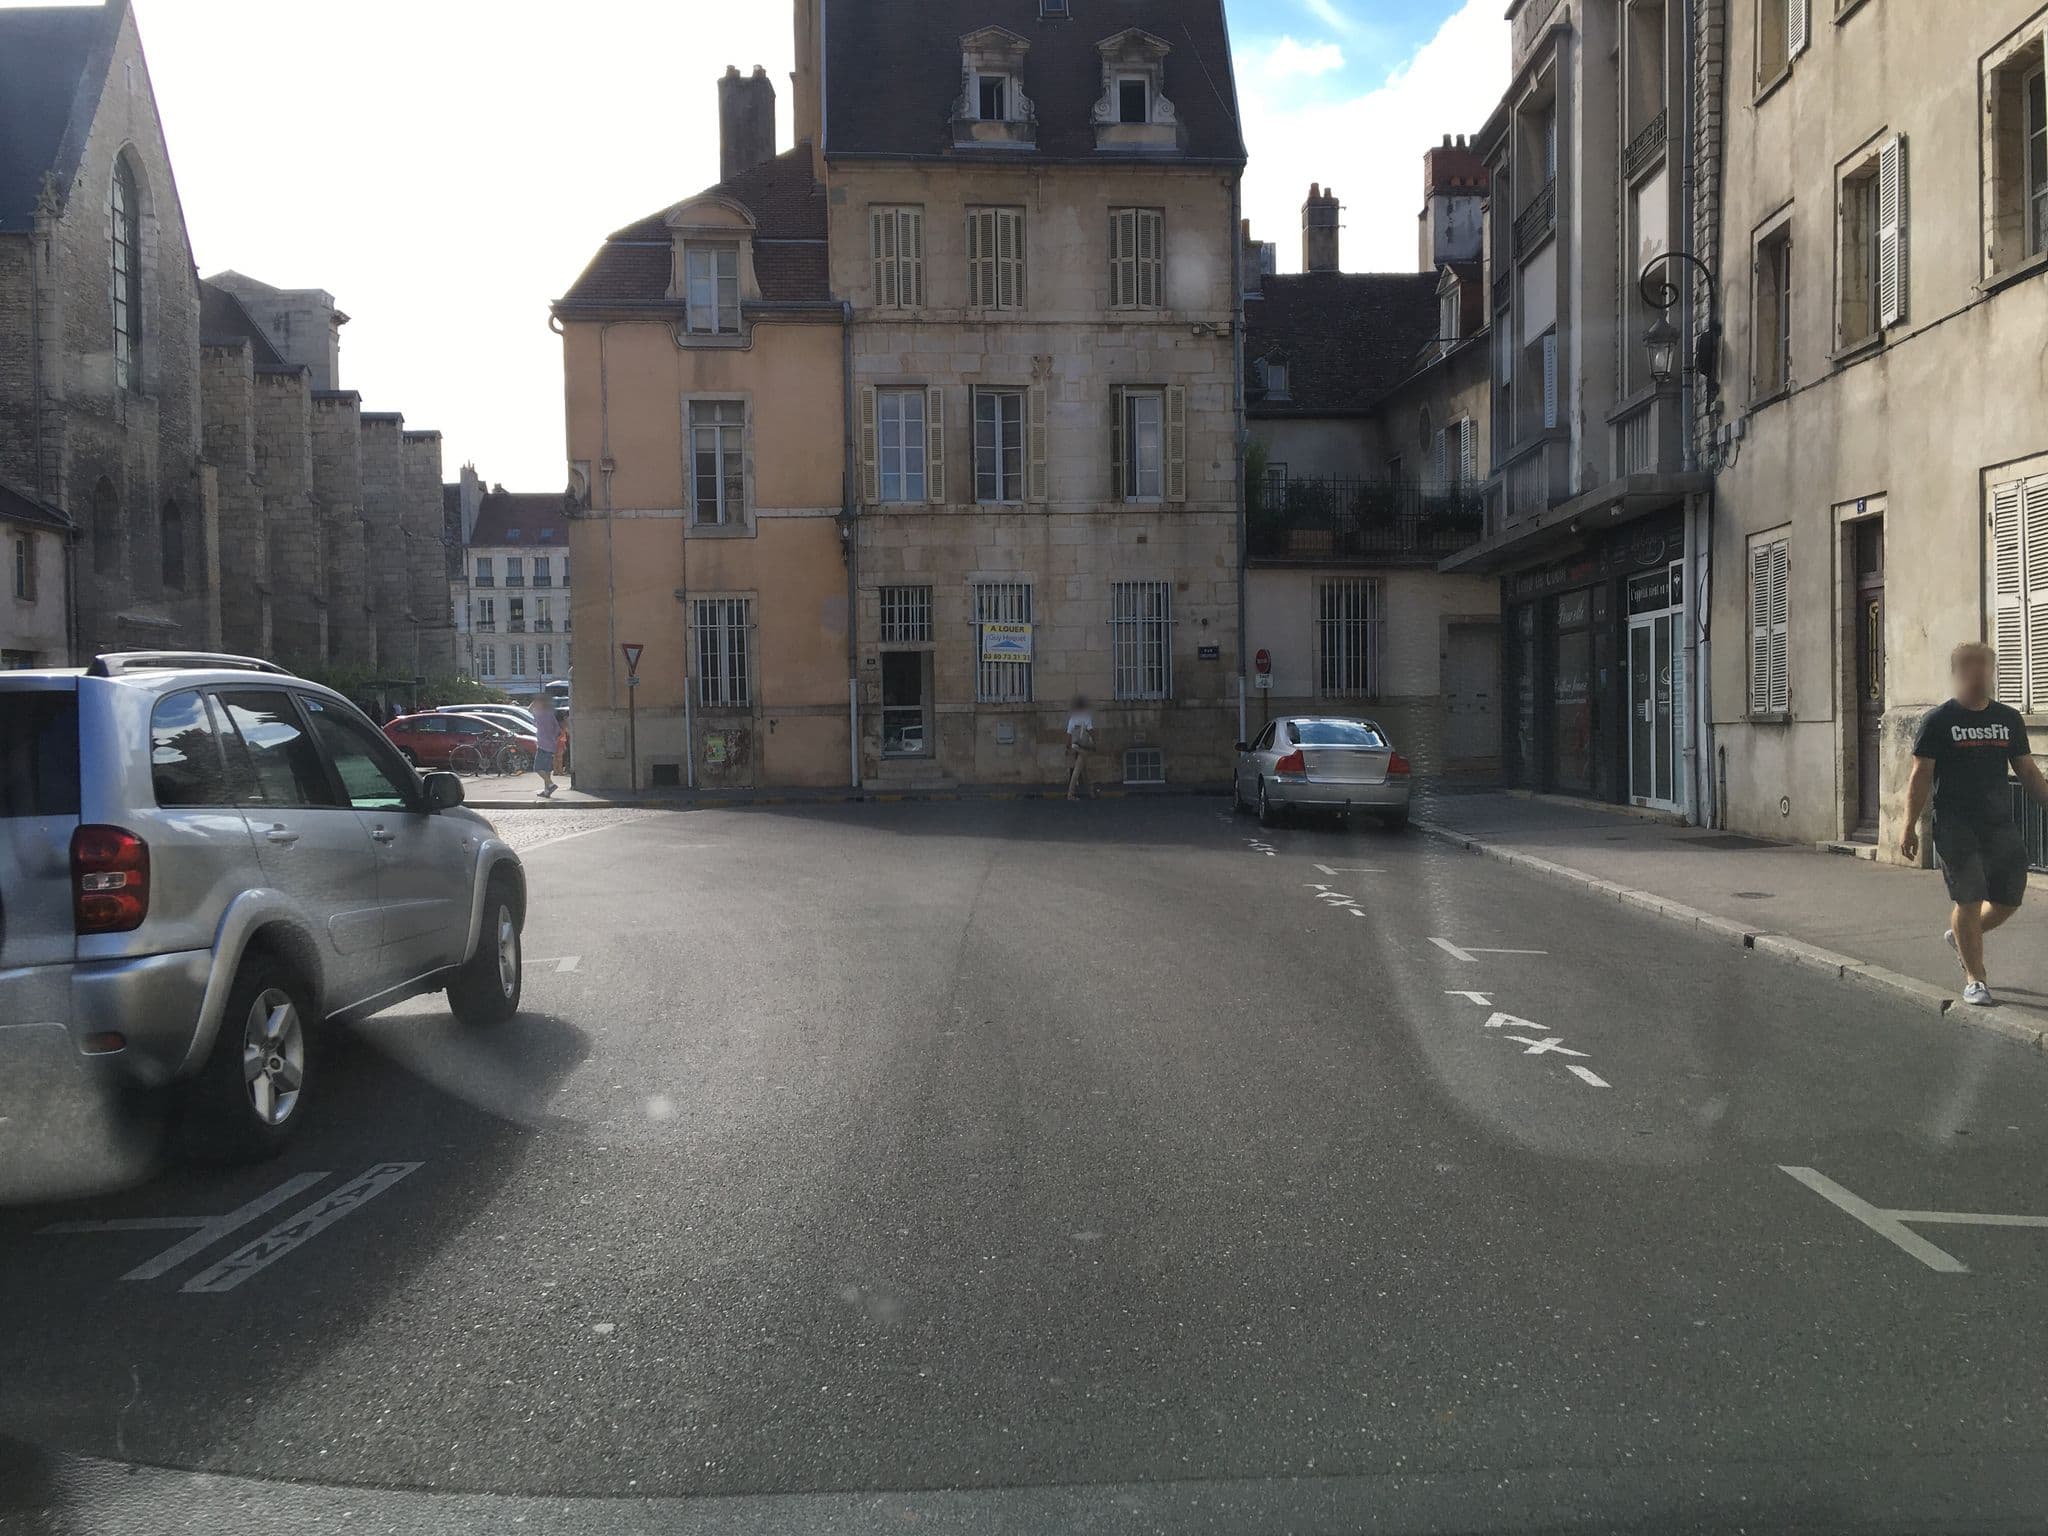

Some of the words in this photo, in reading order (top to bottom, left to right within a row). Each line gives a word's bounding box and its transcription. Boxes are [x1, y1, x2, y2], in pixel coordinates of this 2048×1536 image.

[998, 625, 1025, 633] LOUER
[1951, 723, 2010, 742] CrossFit
[1302, 883, 1367, 917] TAXI
[1444, 990, 1613, 1089] TAXI
[200, 1164, 404, 1288] PAYANT
